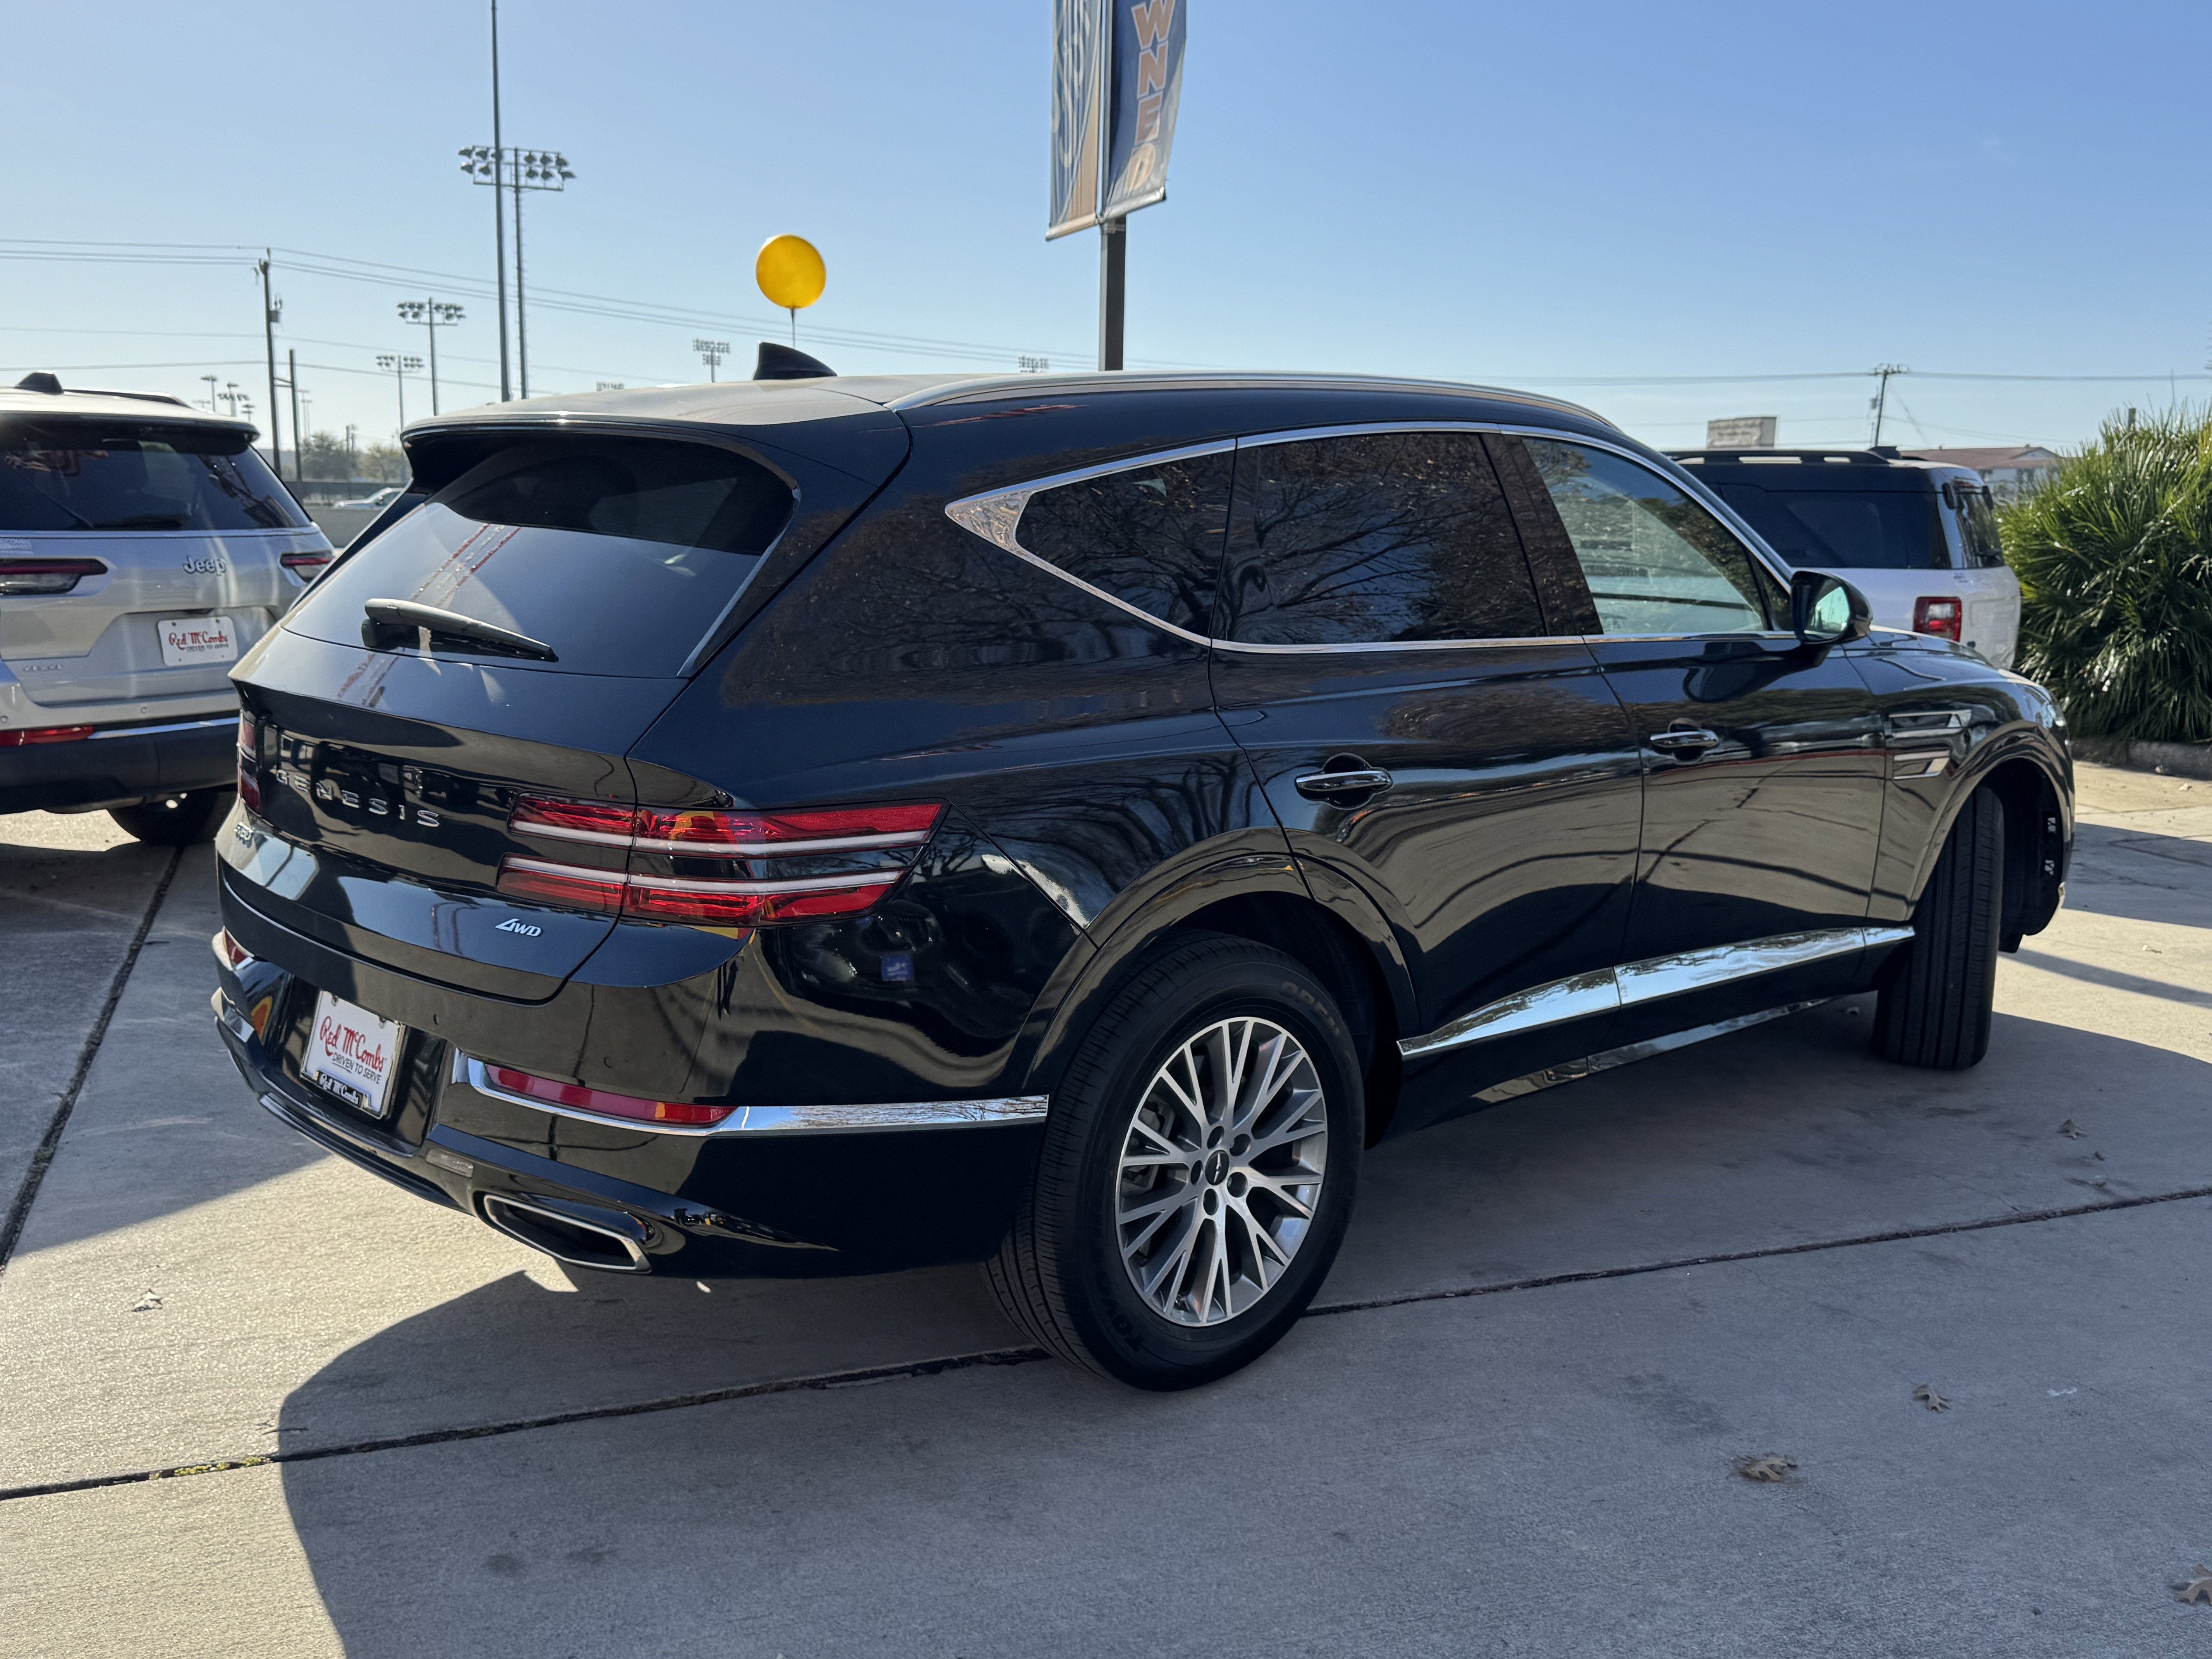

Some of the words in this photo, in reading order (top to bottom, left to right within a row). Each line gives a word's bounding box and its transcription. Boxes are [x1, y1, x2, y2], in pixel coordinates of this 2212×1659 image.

[182, 555, 227, 576] Jeep
[169, 632, 187, 650] Red
[188, 630, 228, 644] McCombs
[276, 769, 440, 827] GENESIS
[495, 918, 541, 936] 4WD
[320, 1016, 341, 1056] Red
[343, 1027, 384, 1072] McCombs
[332, 1053, 354, 1070] DRIVEN
[355, 1063, 363, 1074] TO
[363, 1068, 381, 1084] SERVE
